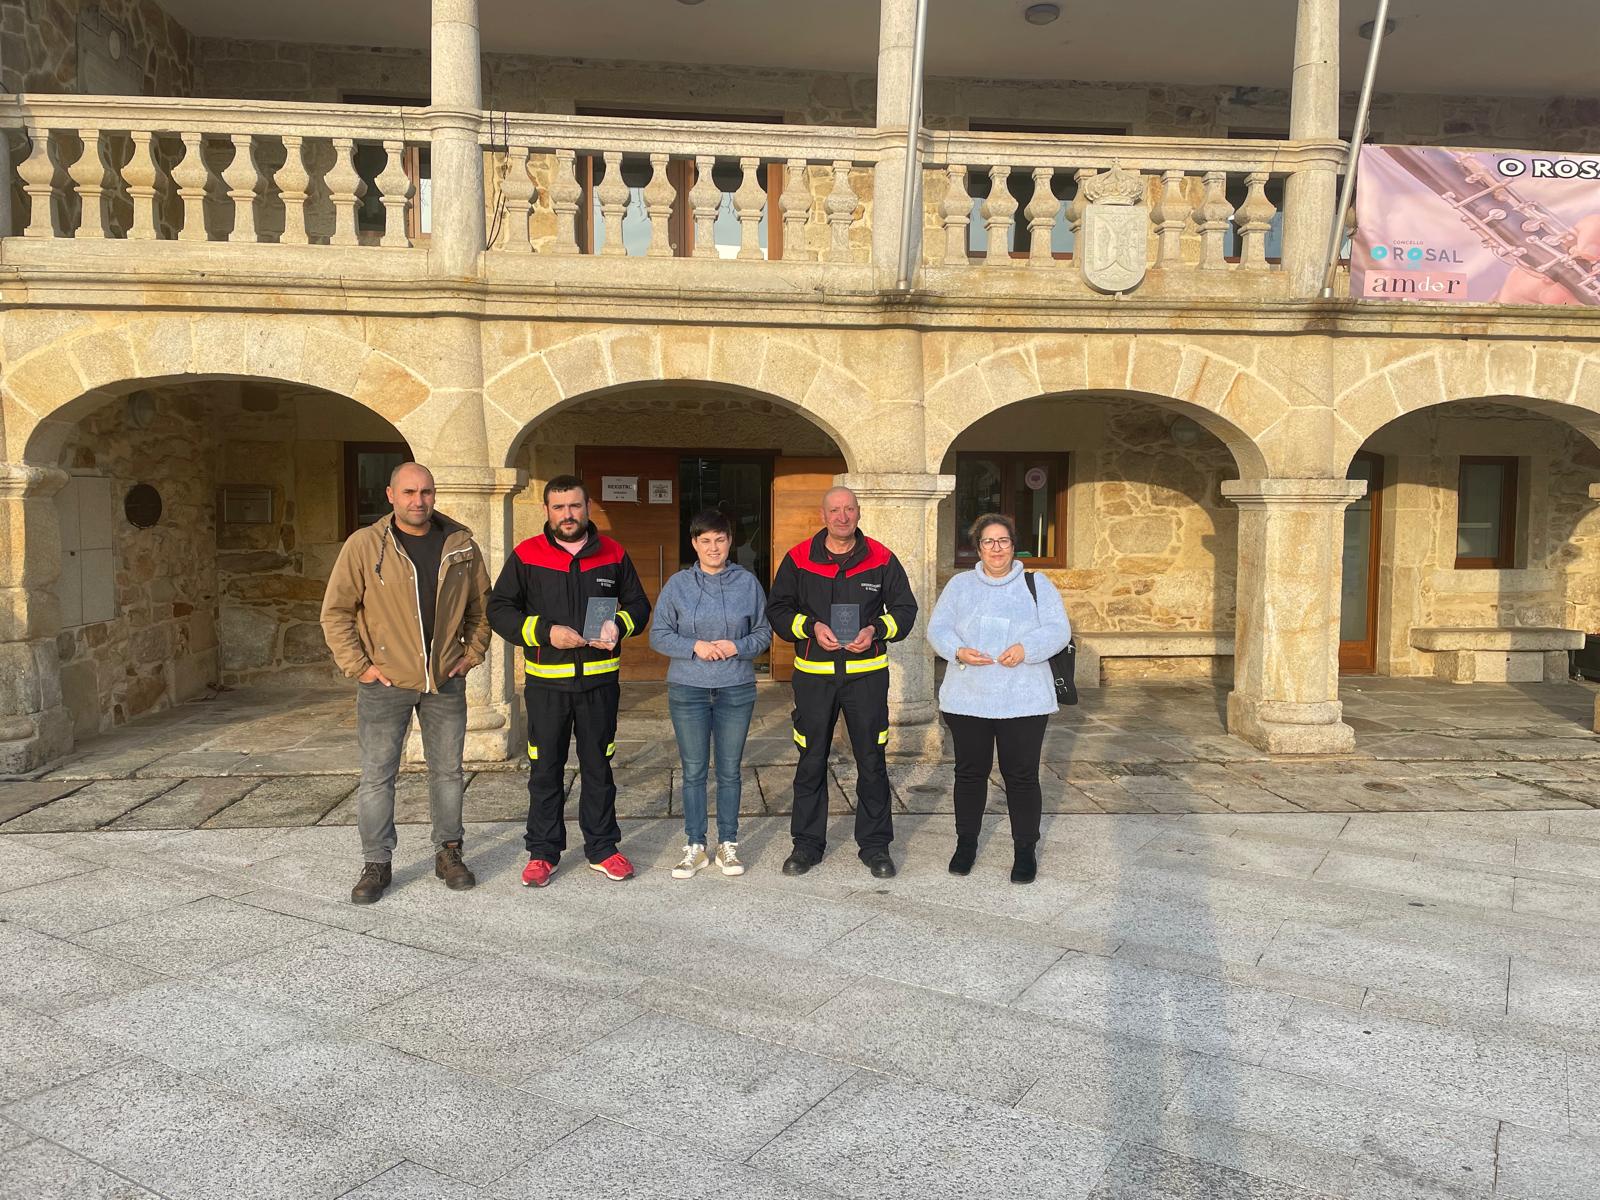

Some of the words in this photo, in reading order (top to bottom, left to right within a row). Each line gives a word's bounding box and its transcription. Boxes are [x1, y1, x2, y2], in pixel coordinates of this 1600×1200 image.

[1497, 158, 1526, 177] O
[1531, 159, 1600, 179] ROS
[1370, 245, 1388, 260] O
[1393, 246, 1464, 263] ROSAL
